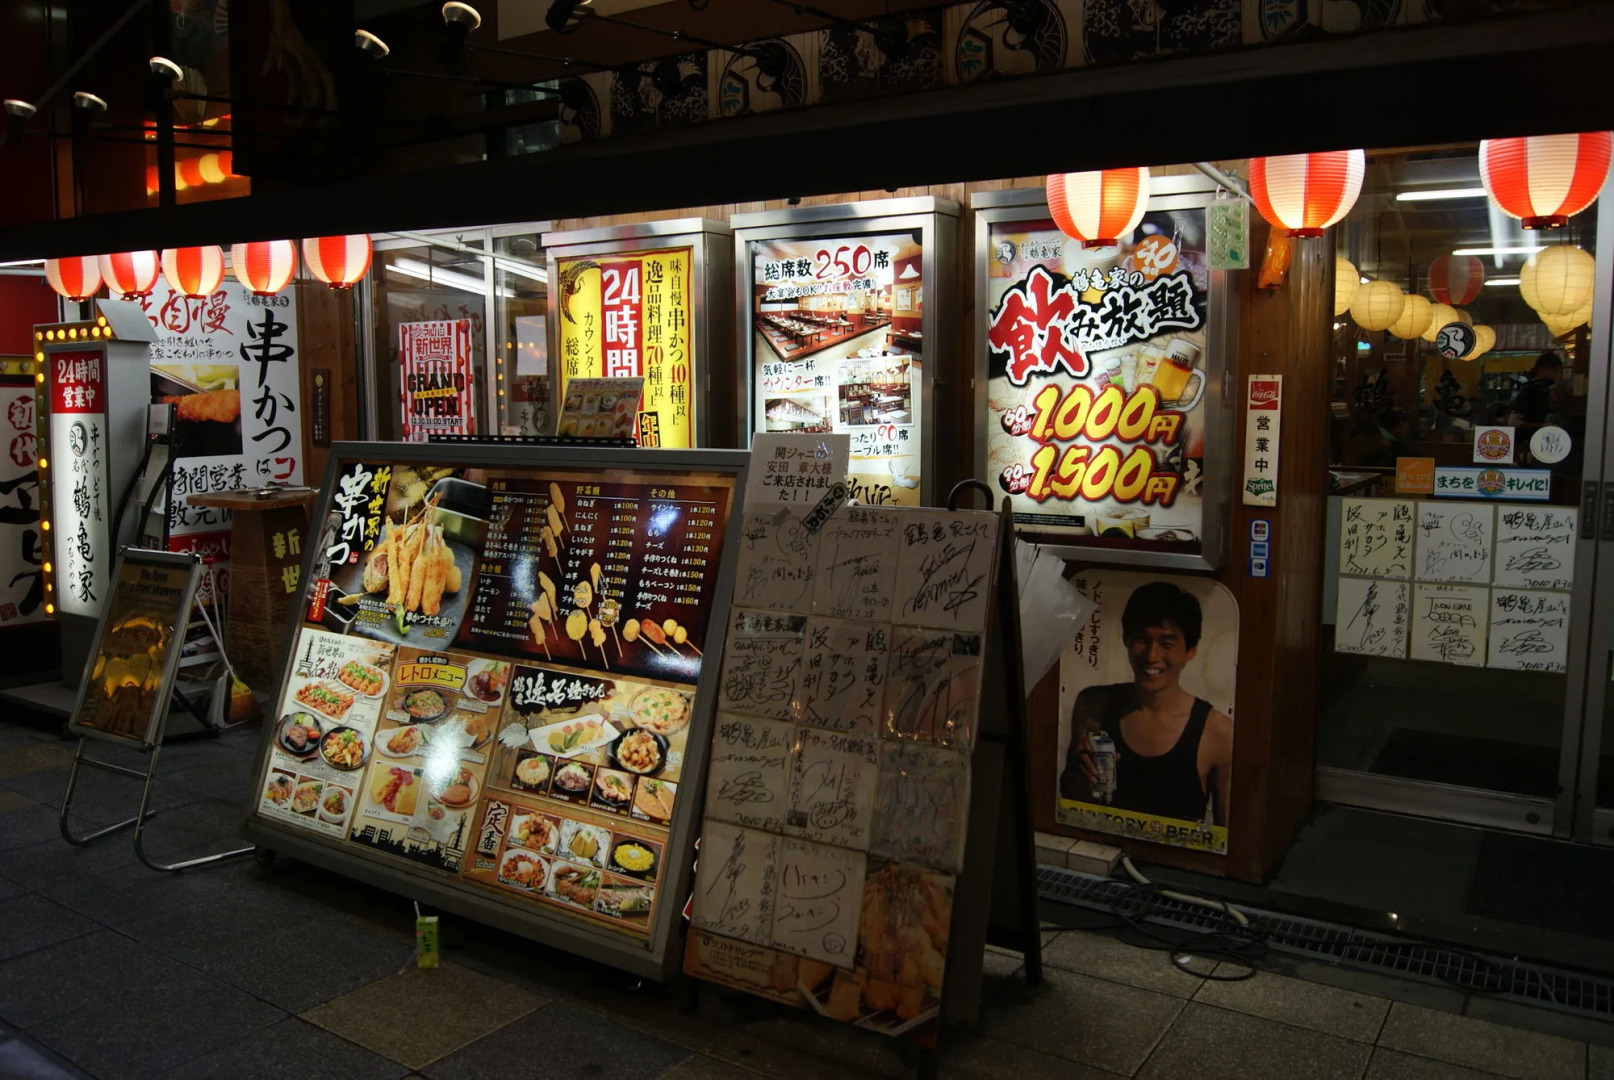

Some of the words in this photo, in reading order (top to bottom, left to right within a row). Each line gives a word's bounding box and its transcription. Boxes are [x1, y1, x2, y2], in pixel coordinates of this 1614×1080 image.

[1072, 266, 1145, 292] 鶴亀家の
[602, 267, 641, 378] 24時間
[645, 260, 664, 407] 逸品料理70種以上
[668, 258, 687, 426] 味自慢串かつ40種以上
[416, 338, 452, 355] 新世界
[57, 358, 101, 385] 24時間
[763, 359, 817, 377] 気軽に一杯
[240, 308, 295, 454] 串かつ
[408, 373, 465, 392] GRAND
[62, 386, 96, 409] 営業中
[414, 397, 458, 415] OPEN
[443, 417, 463, 425] START
[850, 425, 909, 445] ったり90席
[1255, 415, 1270, 473] 営業中
[849, 444, 900, 457] ーブル席!!
[71, 459, 90, 473] 名代
[766, 461, 789, 473] 安田
[798, 461, 833, 475] 章大様
[576, 486, 600, 496] 野菜類
[763, 475, 832, 489] ご来店されまし
[1247, 482, 1272, 492] Sprite
[1437, 475, 1474, 490] まちを
[1506, 477, 1549, 491] キレイに!
[650, 489, 676, 499] その他
[326, 463, 373, 565] 串かつ
[364, 466, 392, 551] 新世界の
[575, 512, 599, 520] にんにく
[573, 523, 594, 532] 玉ねぎ
[73, 477, 97, 603] 鶴亀家
[571, 535, 595, 544] しいたけ
[645, 541, 665, 549] チーズ
[643, 554, 678, 564] 手作りつくね
[635, 601, 653, 610] チーズ
[400, 666, 463, 684] レトロメニュー
[482, 802, 508, 851] 定番
